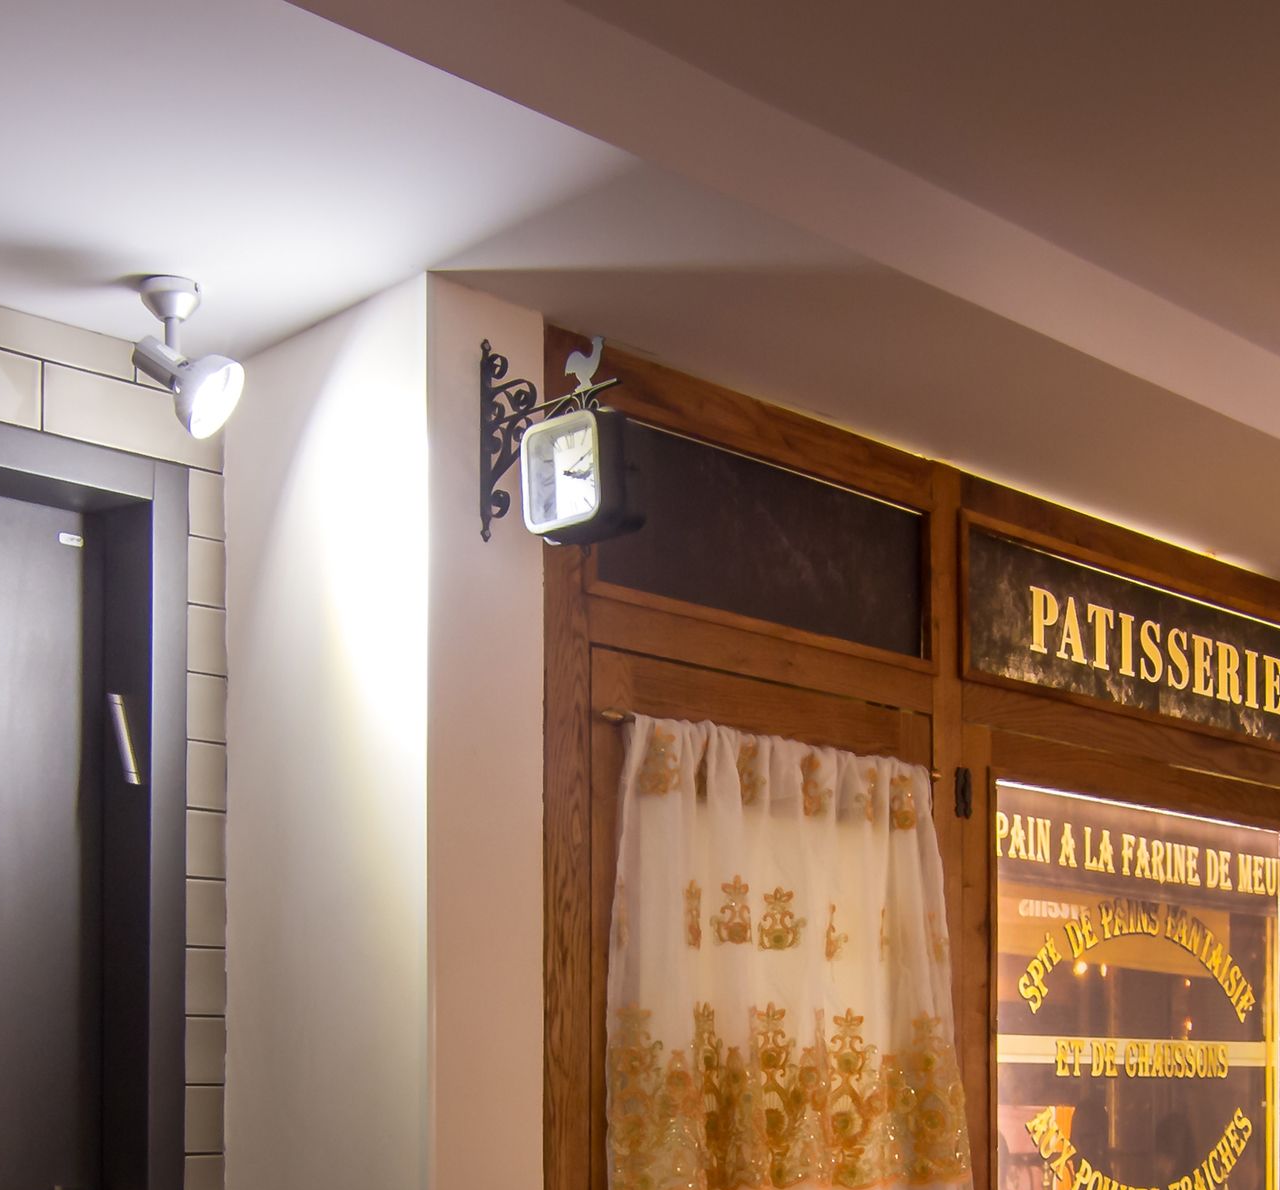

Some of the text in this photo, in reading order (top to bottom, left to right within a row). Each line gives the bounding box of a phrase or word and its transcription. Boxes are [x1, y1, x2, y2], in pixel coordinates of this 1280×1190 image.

[996, 811, 1280, 896] PAIN A LA FARINE DE MEU
[1064, 906, 1099, 959] DE
[1099, 897, 1160, 940] PAINS
[1165, 904, 1256, 1024] FANTAISIE
[1055, 1040, 1229, 1079] ET DE CHAUSSONS
[1025, 1107, 1077, 1181] AUX
